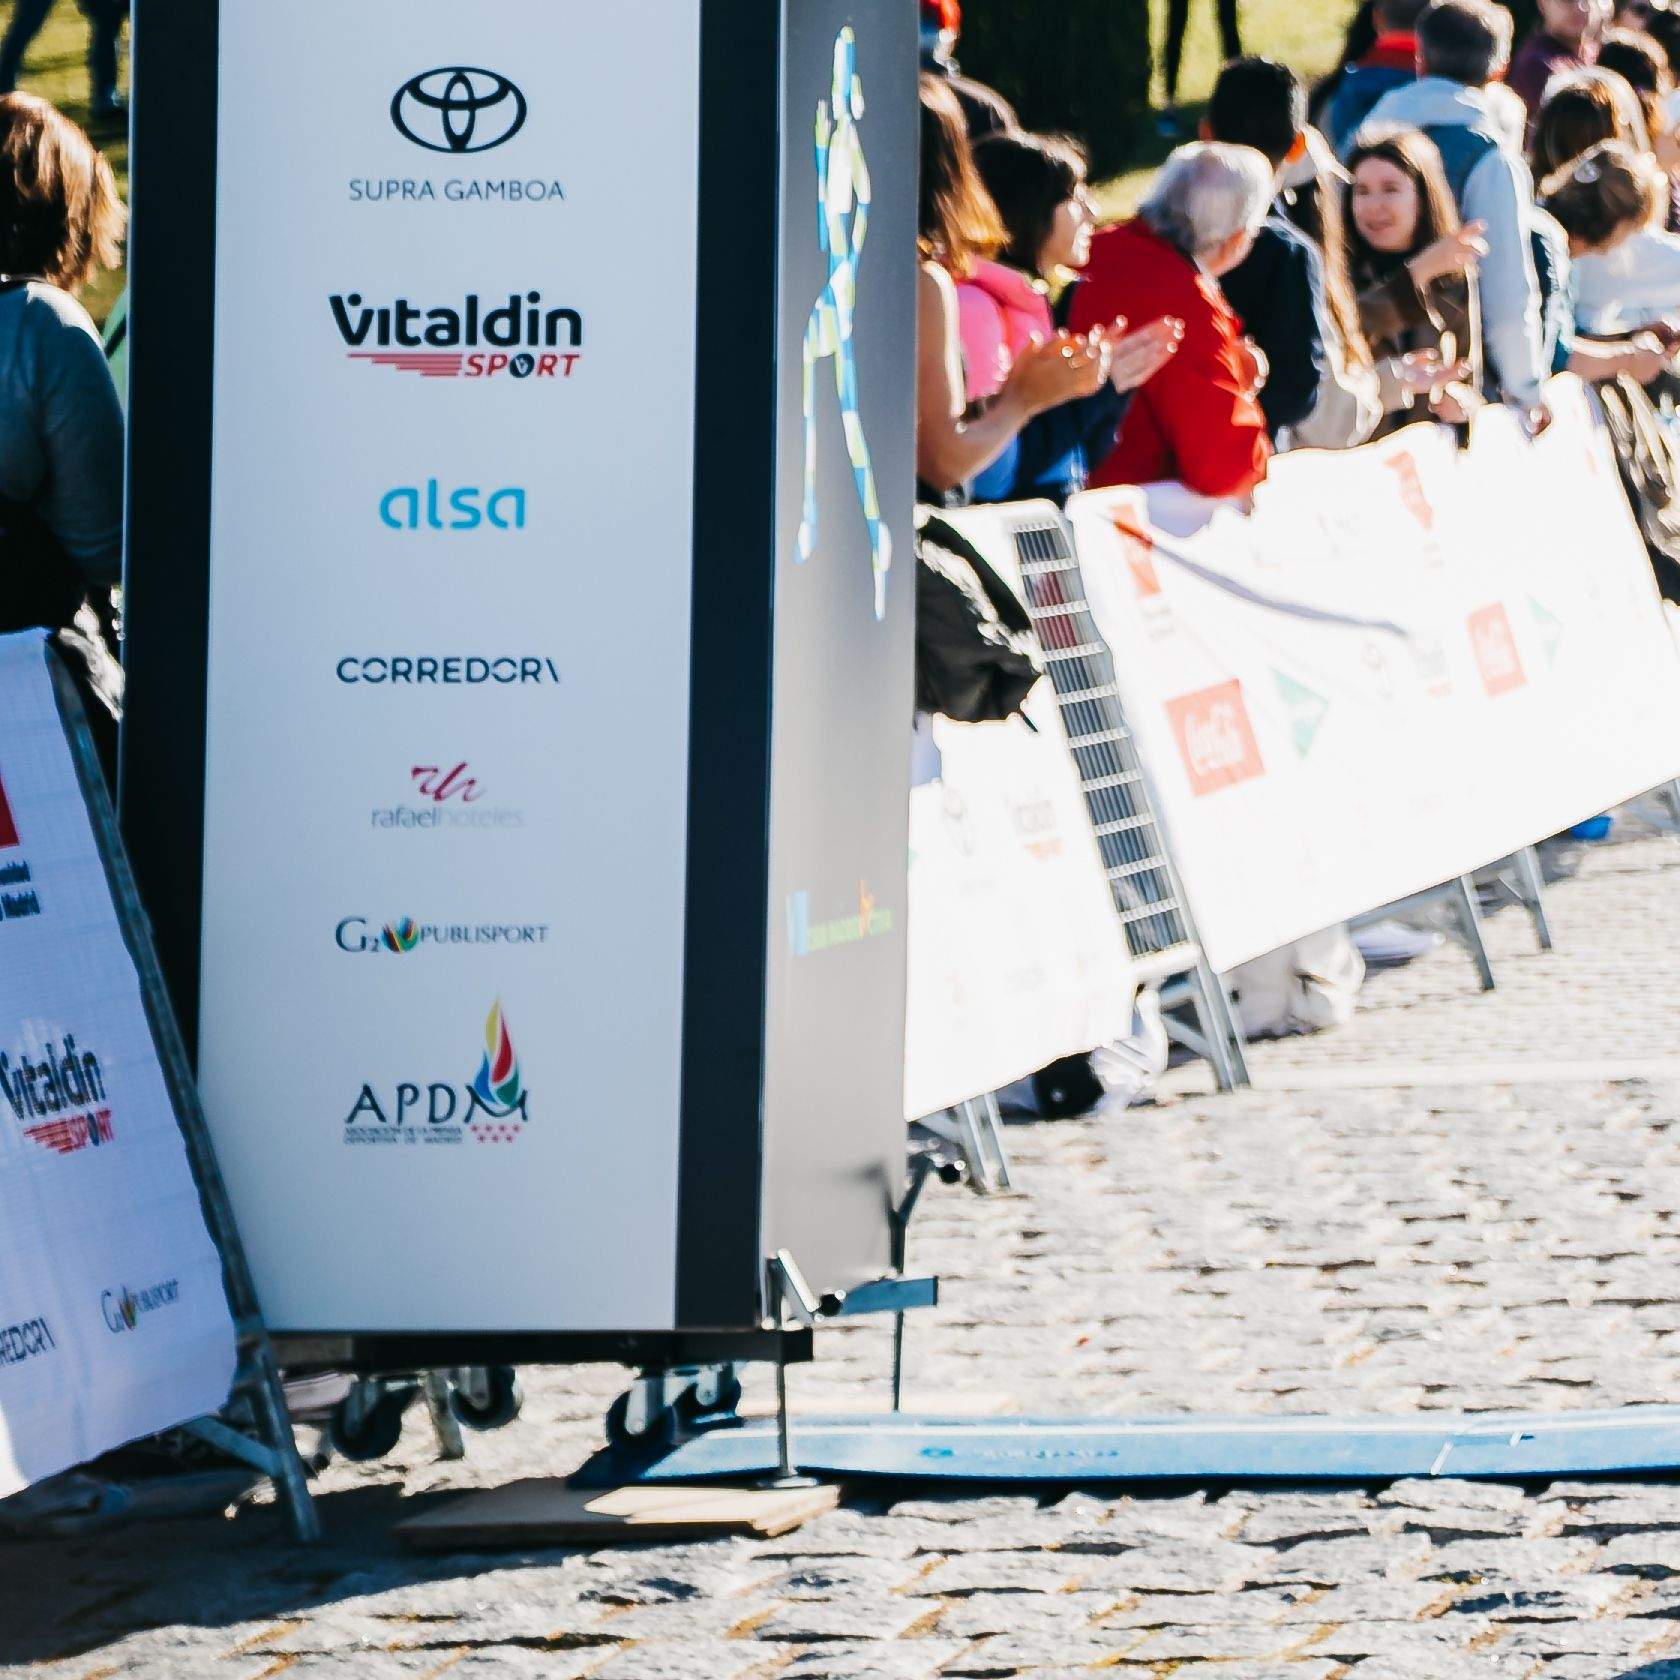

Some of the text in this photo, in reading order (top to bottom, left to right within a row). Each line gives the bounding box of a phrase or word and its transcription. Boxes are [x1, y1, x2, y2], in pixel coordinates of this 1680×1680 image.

[349, 179, 565, 203] SUPRA GAMBOA
[328, 290, 582, 347] Vitaldin
[465, 352, 580, 379] SPORT
[378, 478, 526, 531] alsa
[345, 1082, 529, 1125] APDM
